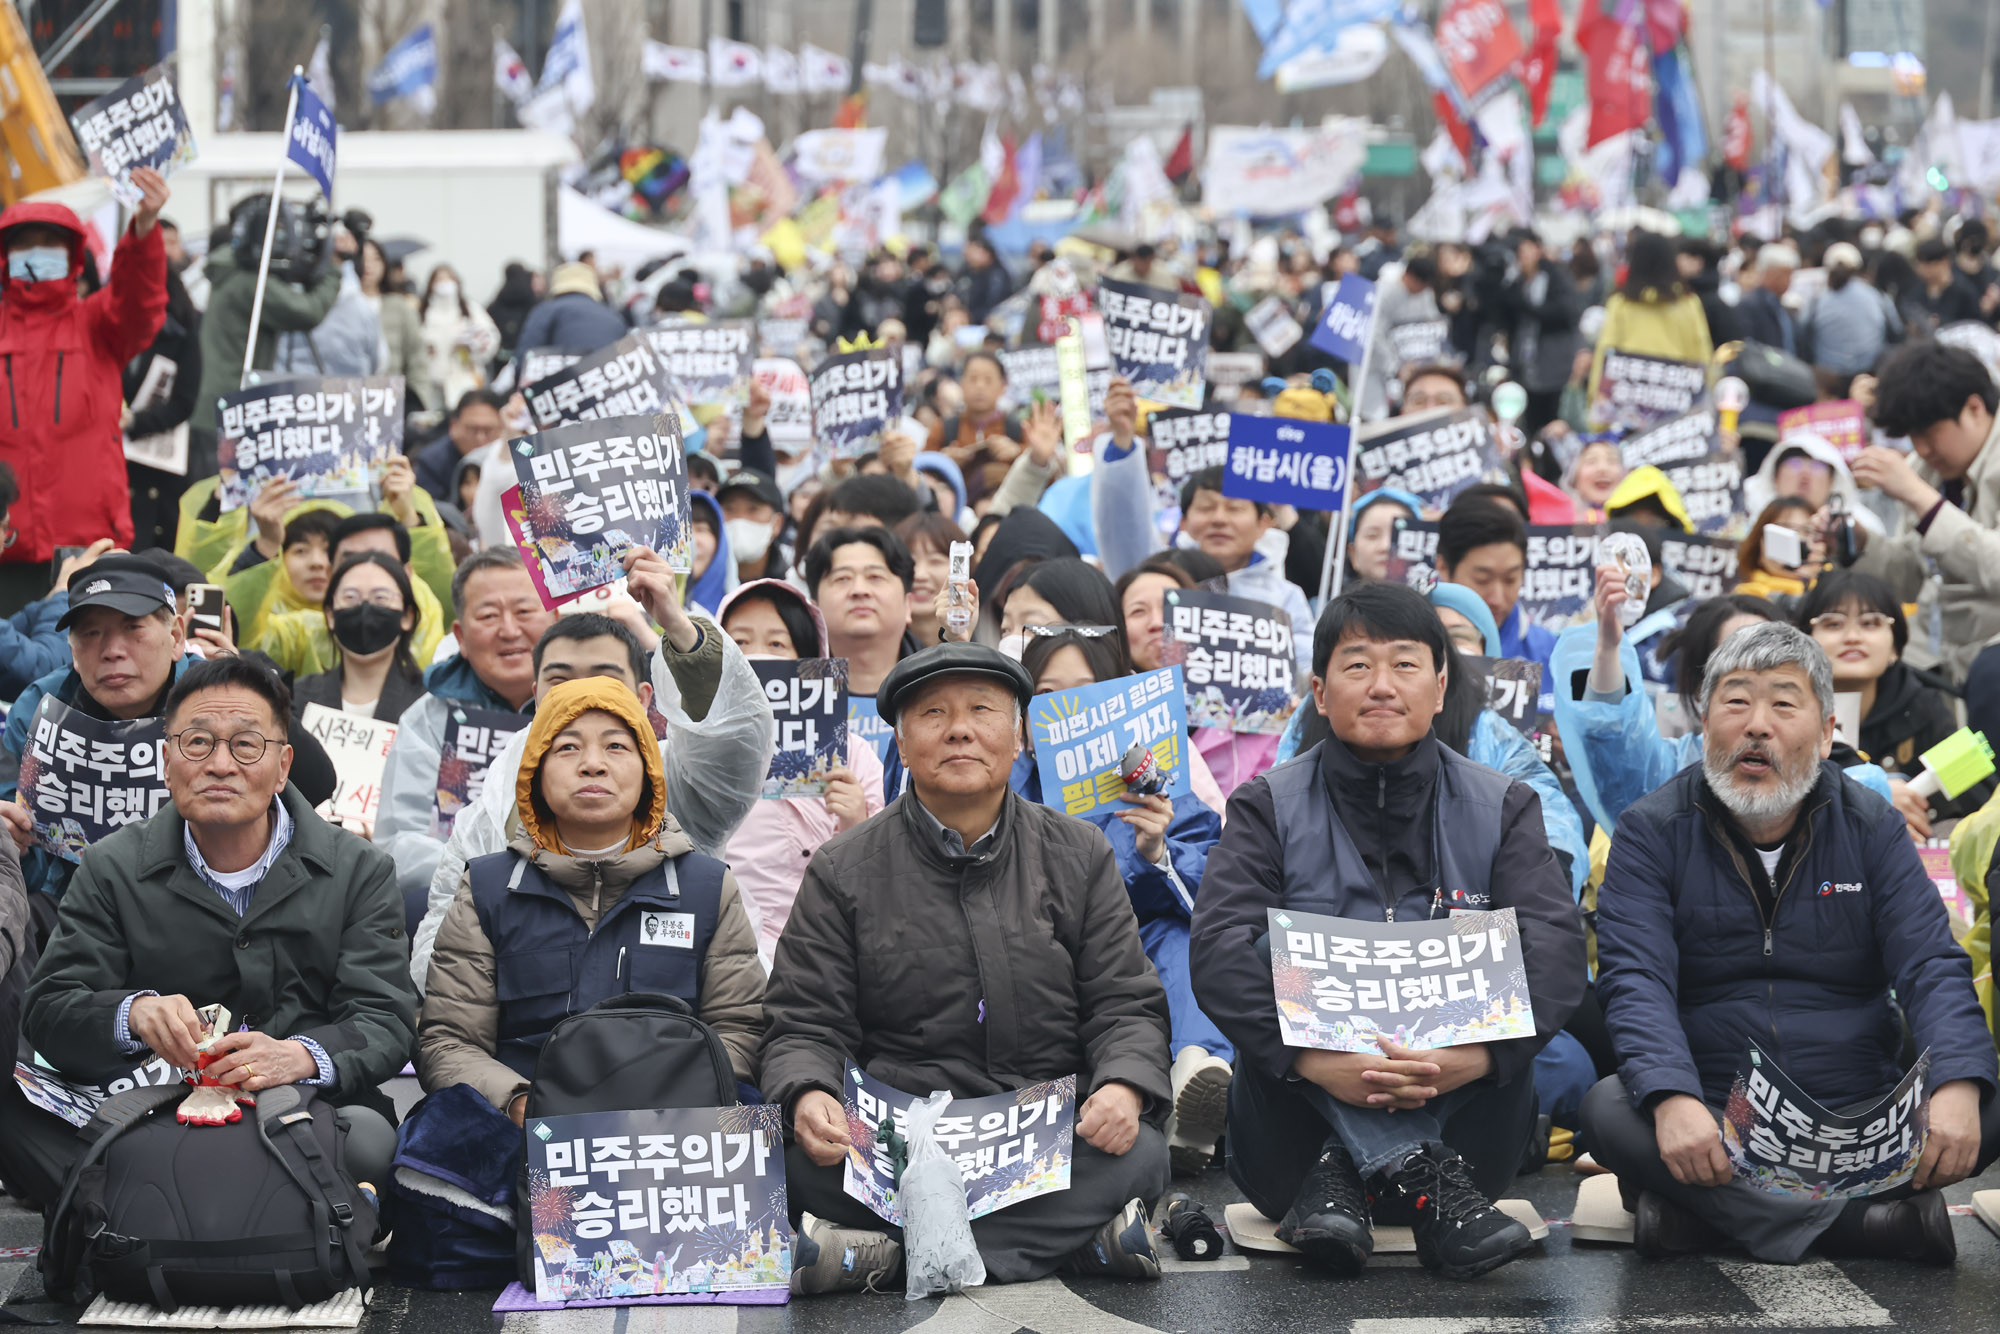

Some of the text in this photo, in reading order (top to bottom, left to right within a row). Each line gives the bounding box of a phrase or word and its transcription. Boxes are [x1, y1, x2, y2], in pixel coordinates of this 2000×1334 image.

[79, 75, 175, 152] 민주주의가
[101, 109, 176, 176] 승리했다
[531, 345, 657, 426] 민주주의가
[222, 391, 356, 439] 민주주의가
[235, 424, 343, 470] 승리했다
[530, 434, 681, 496] 민주주의가
[1231, 446, 1346, 492] 하남시(을)
[1359, 417, 1486, 479] 민주주의가
[563, 479, 679, 535] 승리했다
[1173, 606, 1294, 659] 민주주의가
[1186, 646, 1293, 693] 승리했다
[310, 715, 374, 750] 시작의
[1047, 668, 1175, 746] 파면시킨 힘으로
[1055, 730, 1119, 781] 이제
[1123, 701, 1178, 750] 가자,
[660, 920, 685, 930] 전봉준
[660, 929, 684, 939] 투쟁단
[1286, 928, 1507, 974] 민주주의가
[1312, 968, 1490, 1013] 승리했다
[1746, 1067, 1924, 1150] 민주주의가
[545, 1130, 770, 1188] 민주주의가
[1749, 1123, 1912, 1174] 승리했다
[571, 1184, 750, 1239] 승리했다
